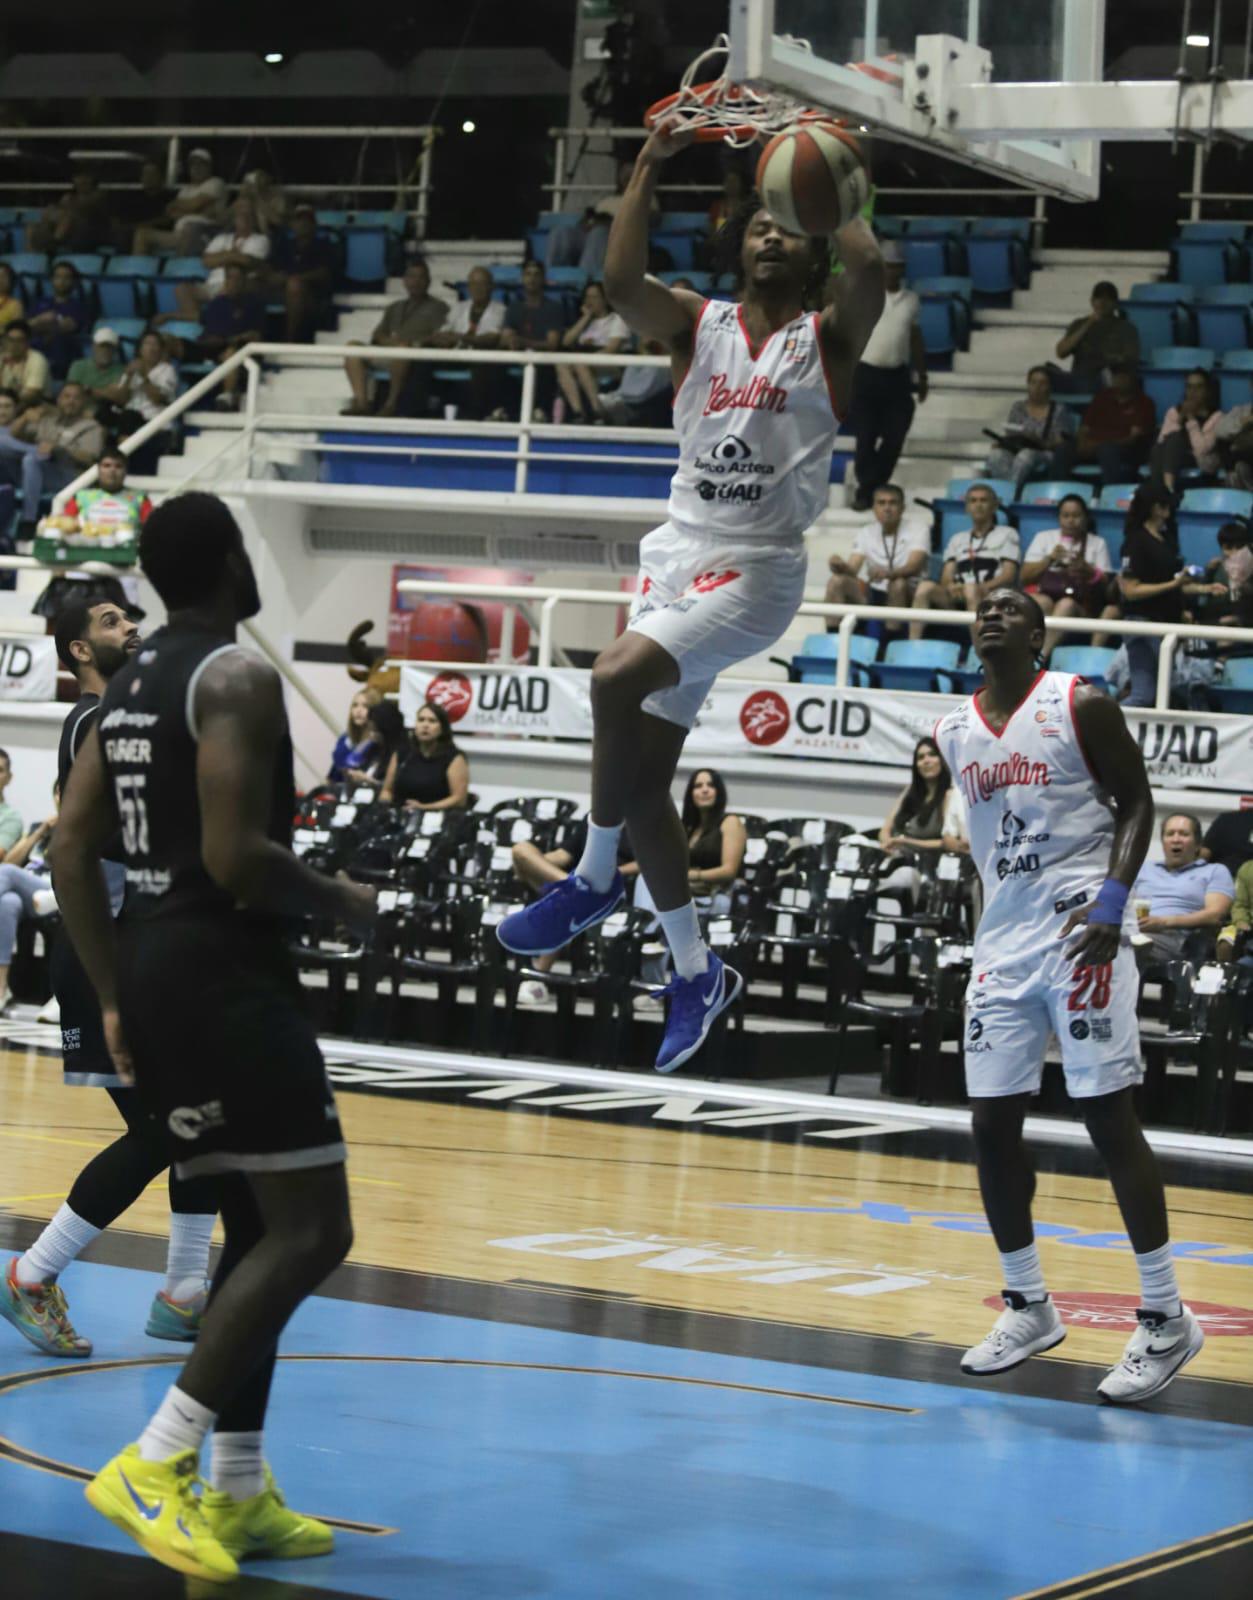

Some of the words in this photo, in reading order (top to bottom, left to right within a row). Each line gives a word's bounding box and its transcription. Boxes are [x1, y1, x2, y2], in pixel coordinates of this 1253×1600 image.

[728, 462, 774, 475] Azteca
[0, 643, 32, 678] ID
[478, 674, 549, 713] UAD
[796, 697, 871, 738] CID
[1138, 722, 1218, 764] UAD
[1068, 961, 1113, 1011] 28
[486, 1232, 931, 1297] UAD
